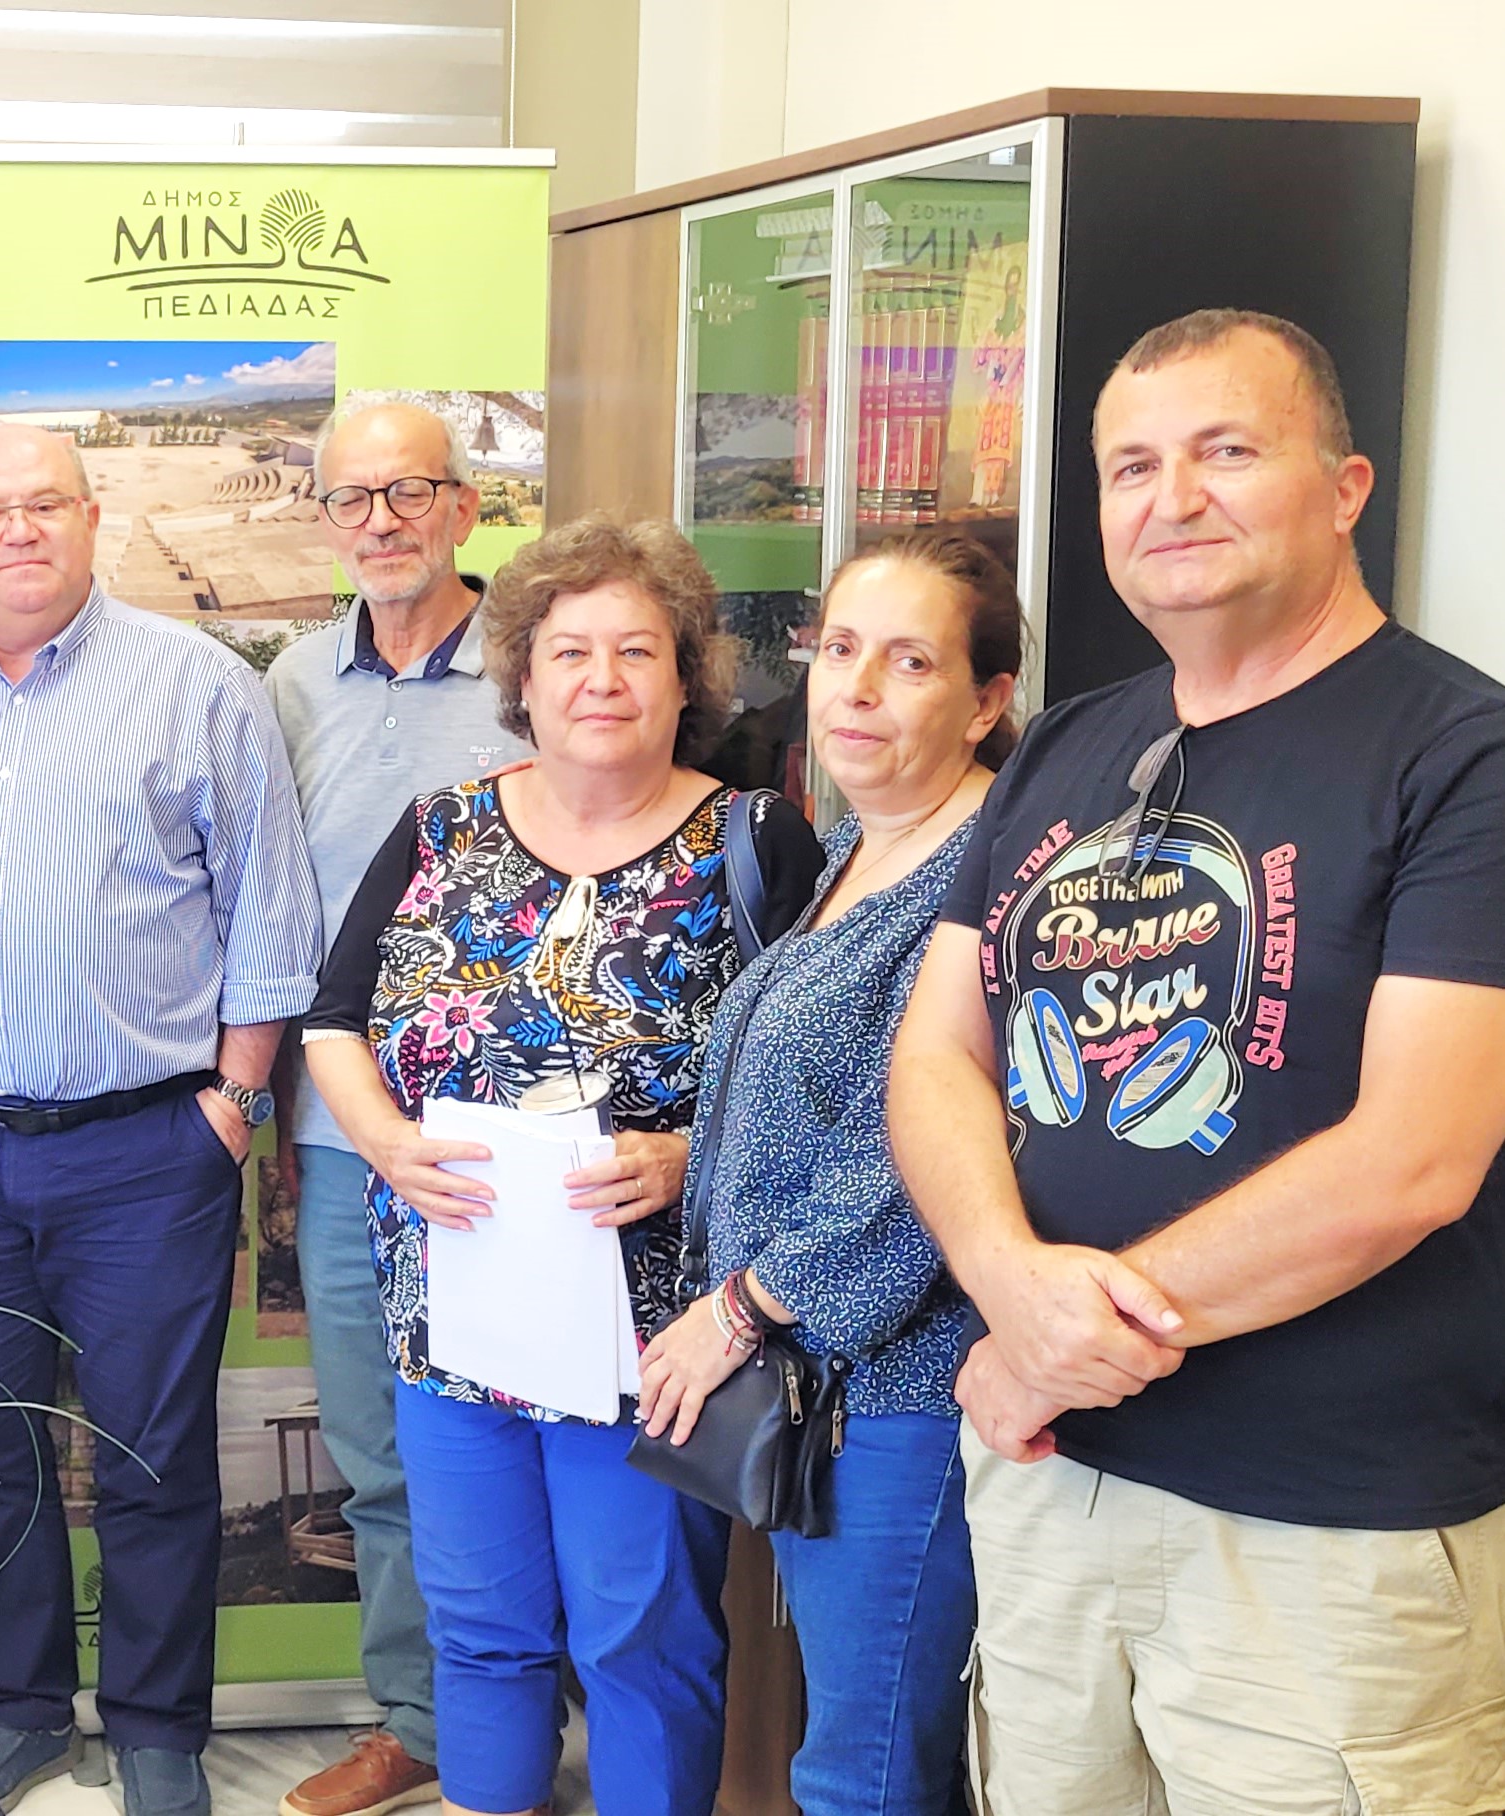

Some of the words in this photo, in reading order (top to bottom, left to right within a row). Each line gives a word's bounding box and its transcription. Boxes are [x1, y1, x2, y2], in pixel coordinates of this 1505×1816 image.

[142, 190, 242, 207] ΔΗΜΟΣ
[143, 293, 342, 320] ΠΕΔΙΑΔΑΣ
[985, 889, 1018, 935] ALL
[1013, 818, 1075, 882] TIME
[1141, 868, 1184, 899] WITH
[1032, 902, 1221, 971] Brave
[1261, 842, 1298, 991] GREATEST
[1074, 963, 1208, 1037] Star
[1245, 994, 1288, 1071] HITS
